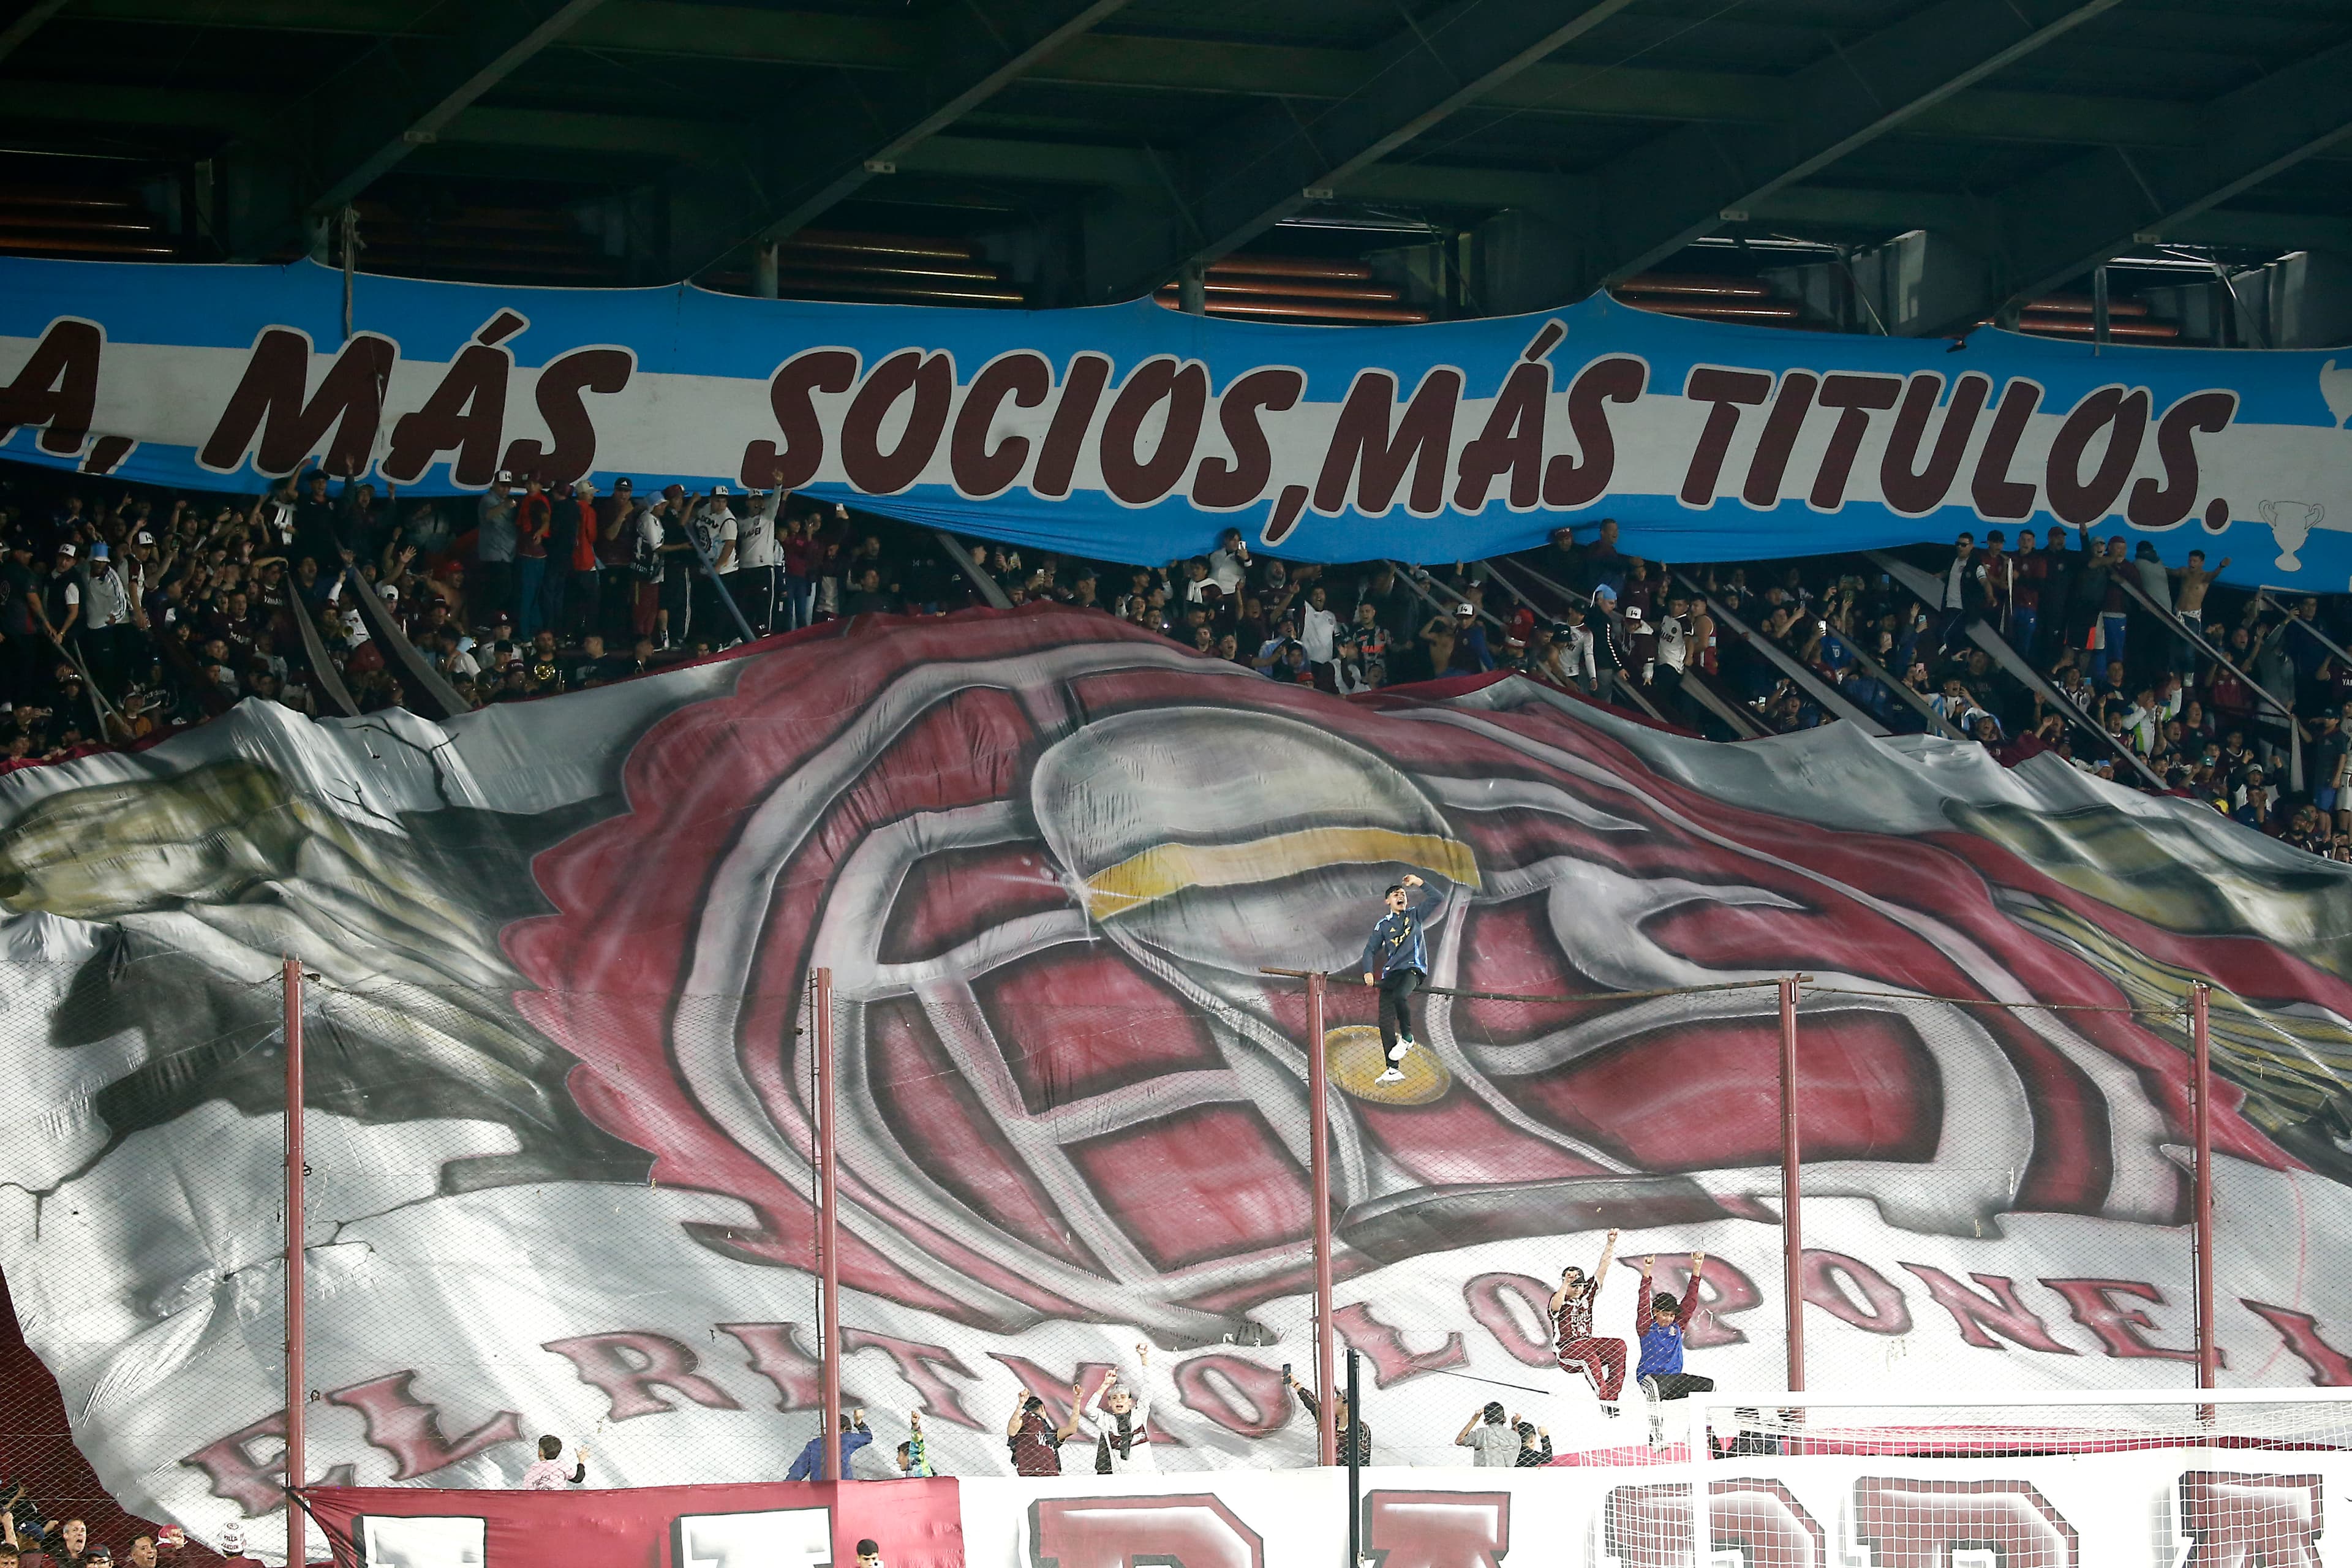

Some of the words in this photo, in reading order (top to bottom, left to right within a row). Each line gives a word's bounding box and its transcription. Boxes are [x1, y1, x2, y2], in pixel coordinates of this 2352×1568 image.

[195, 306, 638, 491] MÁS
[1676, 363, 2239, 535] TITULOS.
[1310, 1271, 1560, 1392] LO
[1615, 1248, 2232, 1372] PONE
